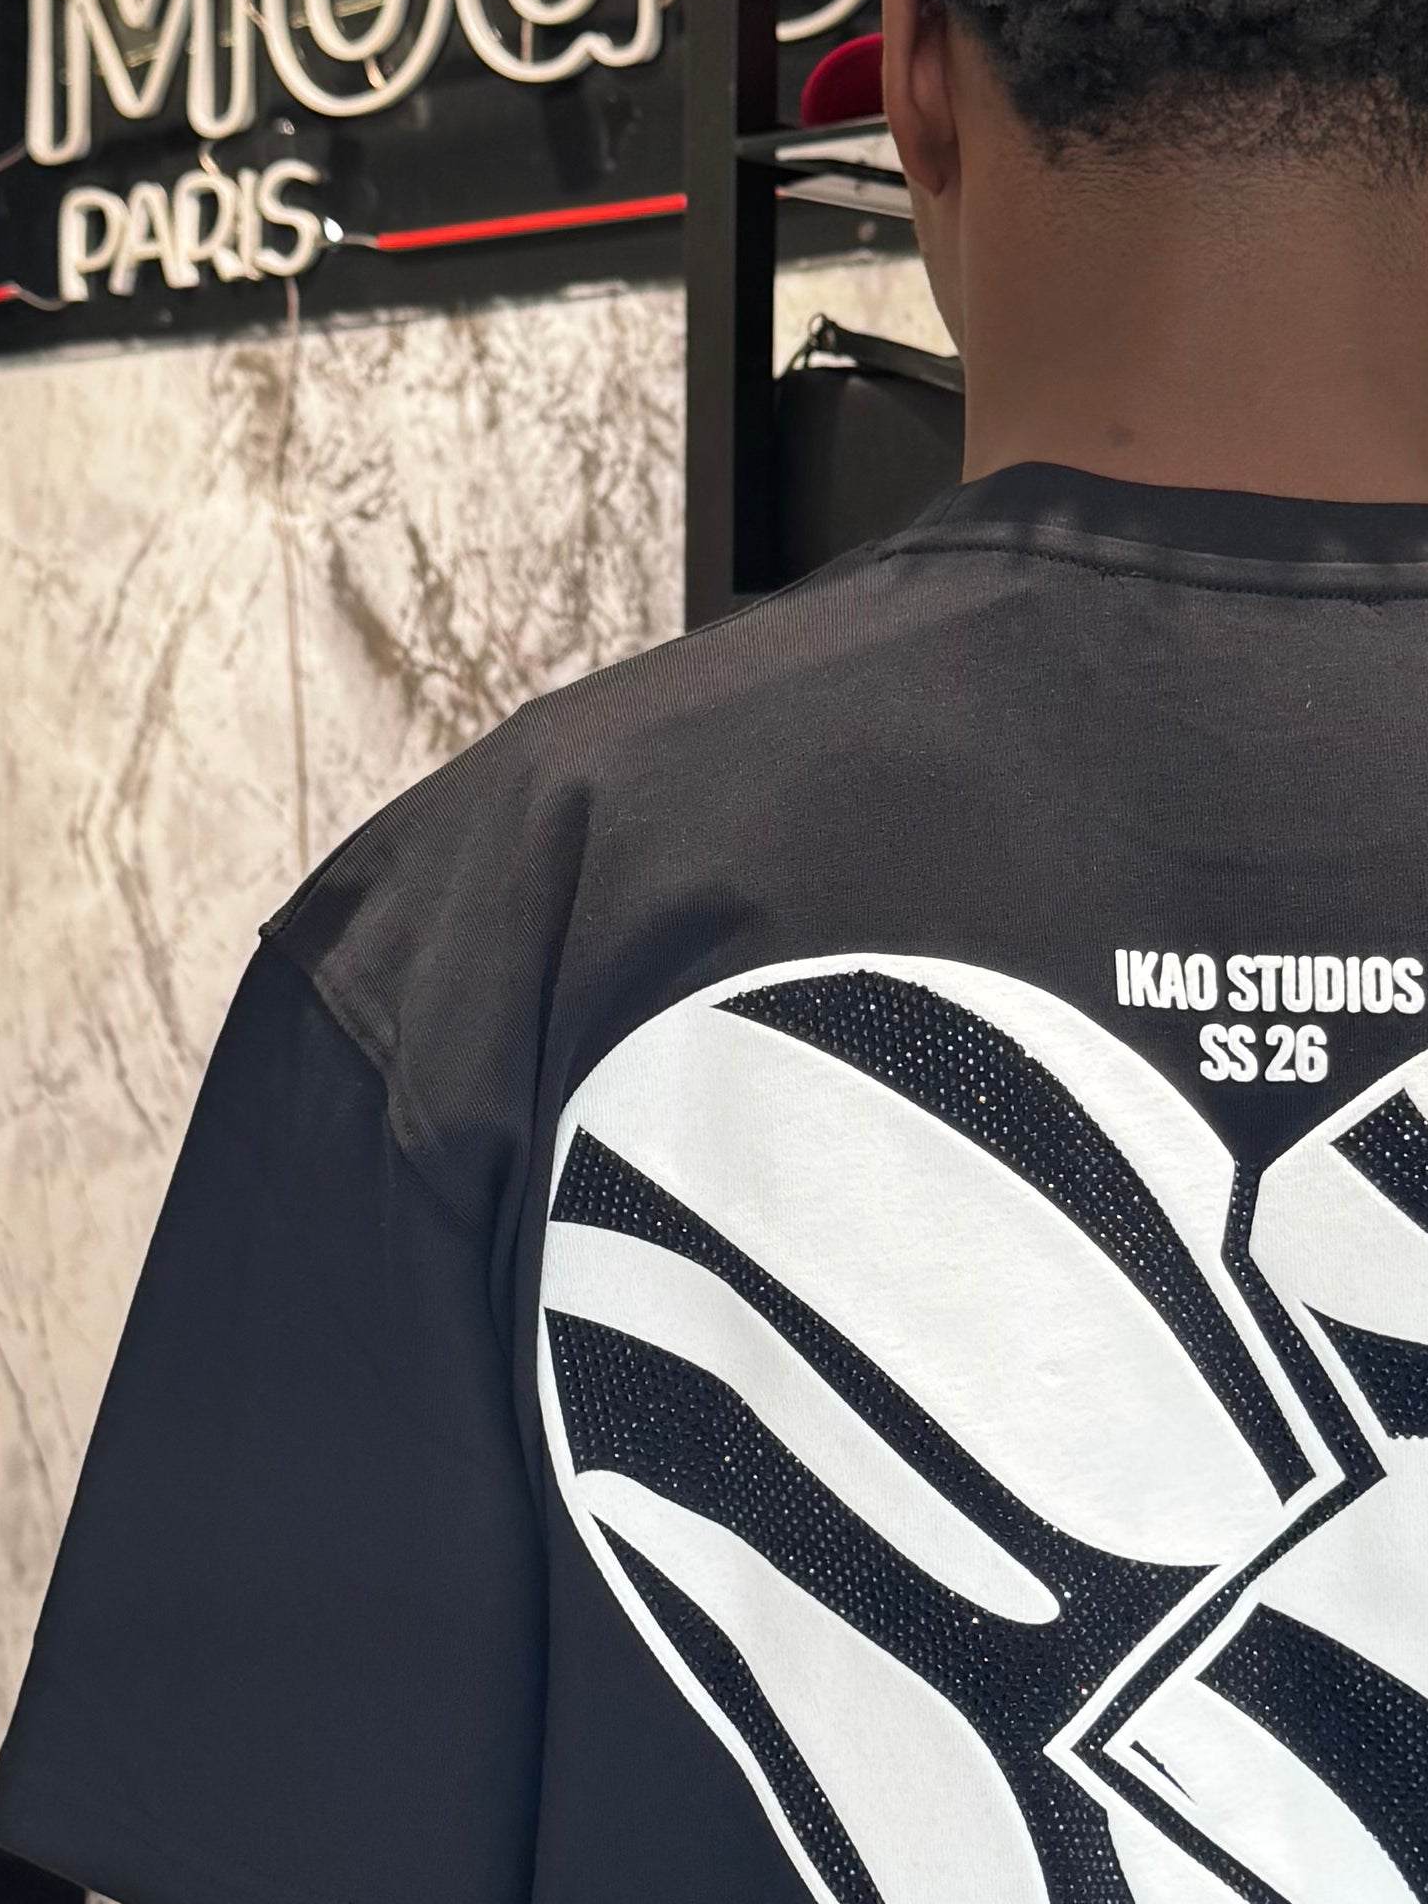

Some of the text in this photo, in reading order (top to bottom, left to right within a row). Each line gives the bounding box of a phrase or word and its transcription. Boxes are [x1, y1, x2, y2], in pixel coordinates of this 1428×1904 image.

[58, 158, 322, 302] PARIS
[1114, 948, 1426, 1015] IKAO STUDIOS
[1199, 1022, 1328, 1083] SS 26
